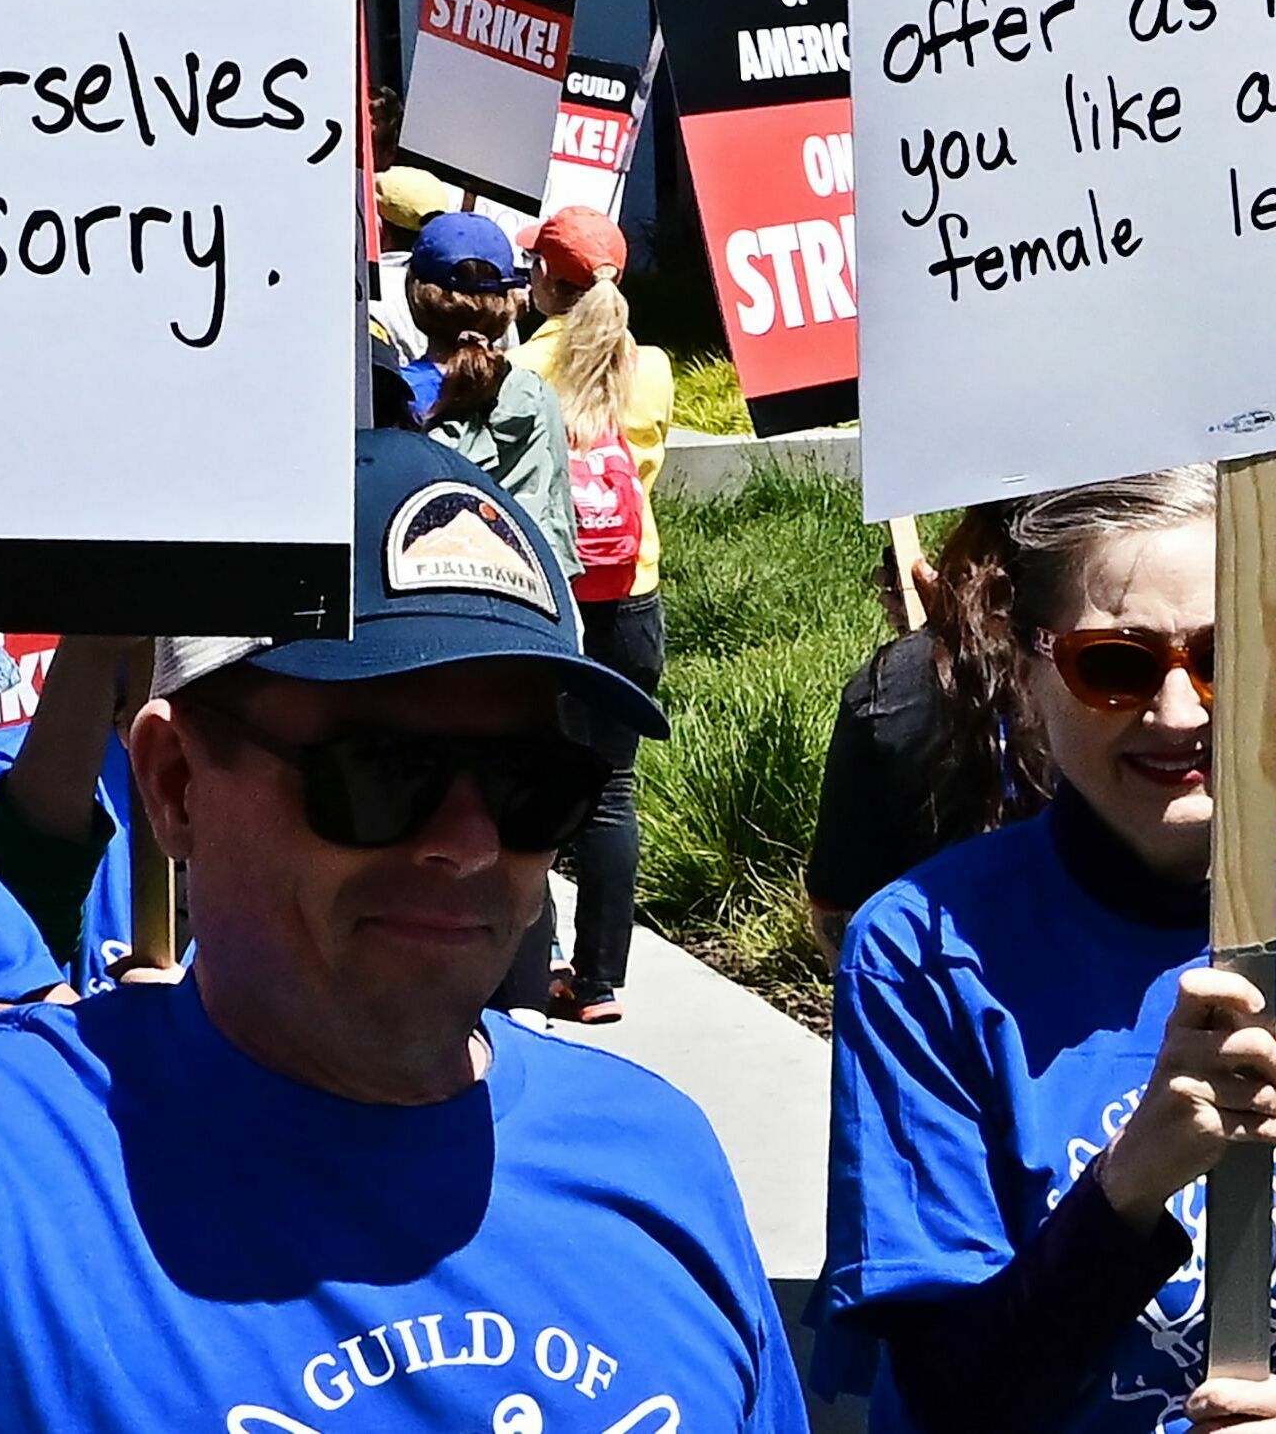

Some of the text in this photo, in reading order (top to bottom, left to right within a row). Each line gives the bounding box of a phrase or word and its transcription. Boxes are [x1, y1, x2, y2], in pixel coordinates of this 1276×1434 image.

[567, 72, 625, 101] GUILD
[803, 133, 851, 196] ON
[901, 128, 1017, 228] you
[1066, 74, 1181, 153] like
[928, 188, 1144, 301] female
[303, 1310, 618, 1411] GUILD OF
